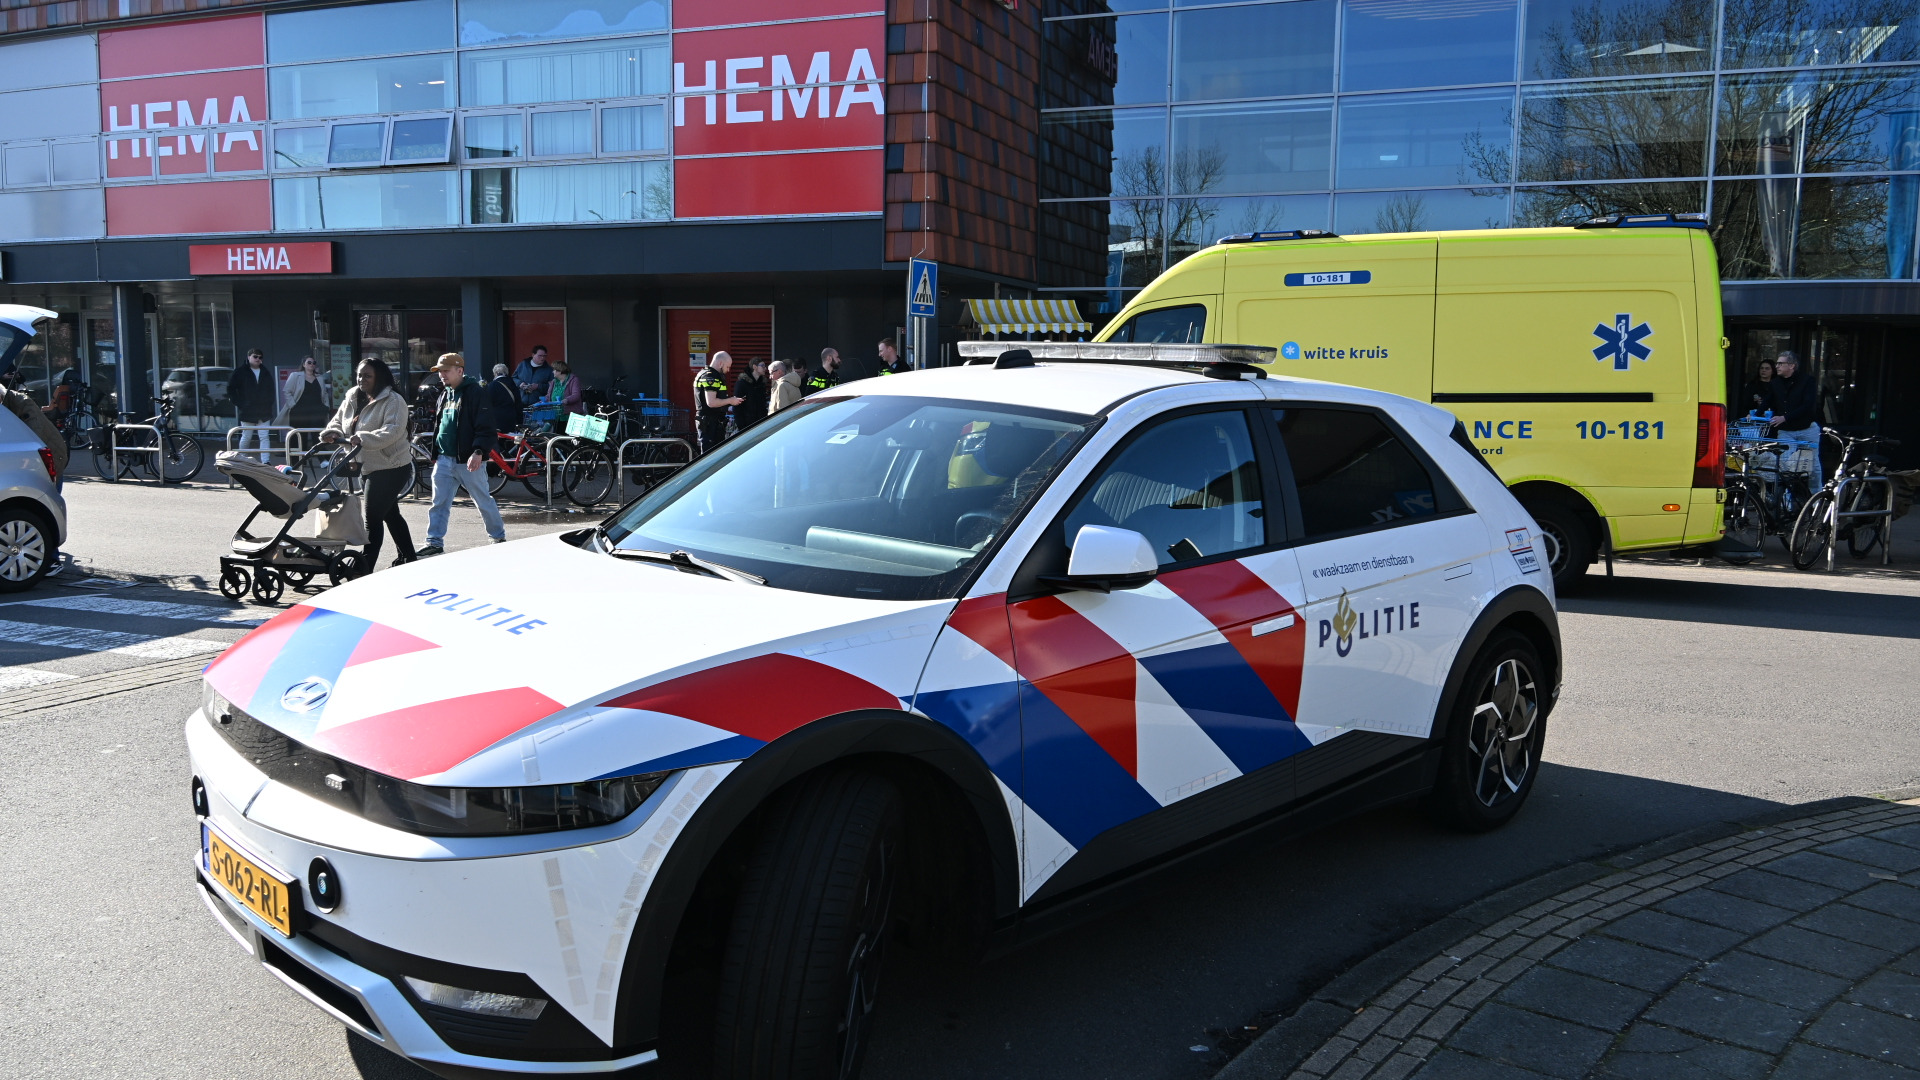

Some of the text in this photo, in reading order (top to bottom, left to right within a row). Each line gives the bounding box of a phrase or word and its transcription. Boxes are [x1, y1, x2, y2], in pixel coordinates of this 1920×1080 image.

[674, 48, 884, 126] HEMA
[109, 95, 259, 160] HEMA
[227, 246, 292, 271] HEMA
[1310, 274, 1344, 283] 10-181
[1303, 345, 1389, 360] witte kruis
[1460, 420, 1533, 439] NCE
[1575, 420, 1664, 440] 10-181
[1477, 446, 1503, 455] ord
[1318, 562, 1361, 578] waakzaam
[1361, 560, 1372, 571] en
[1371, 554, 1408, 569] dienstbaar
[404, 588, 549, 635] POLITIE
[1319, 601, 1420, 658] POLITIE
[211, 840, 285, 925] S-062-RL
